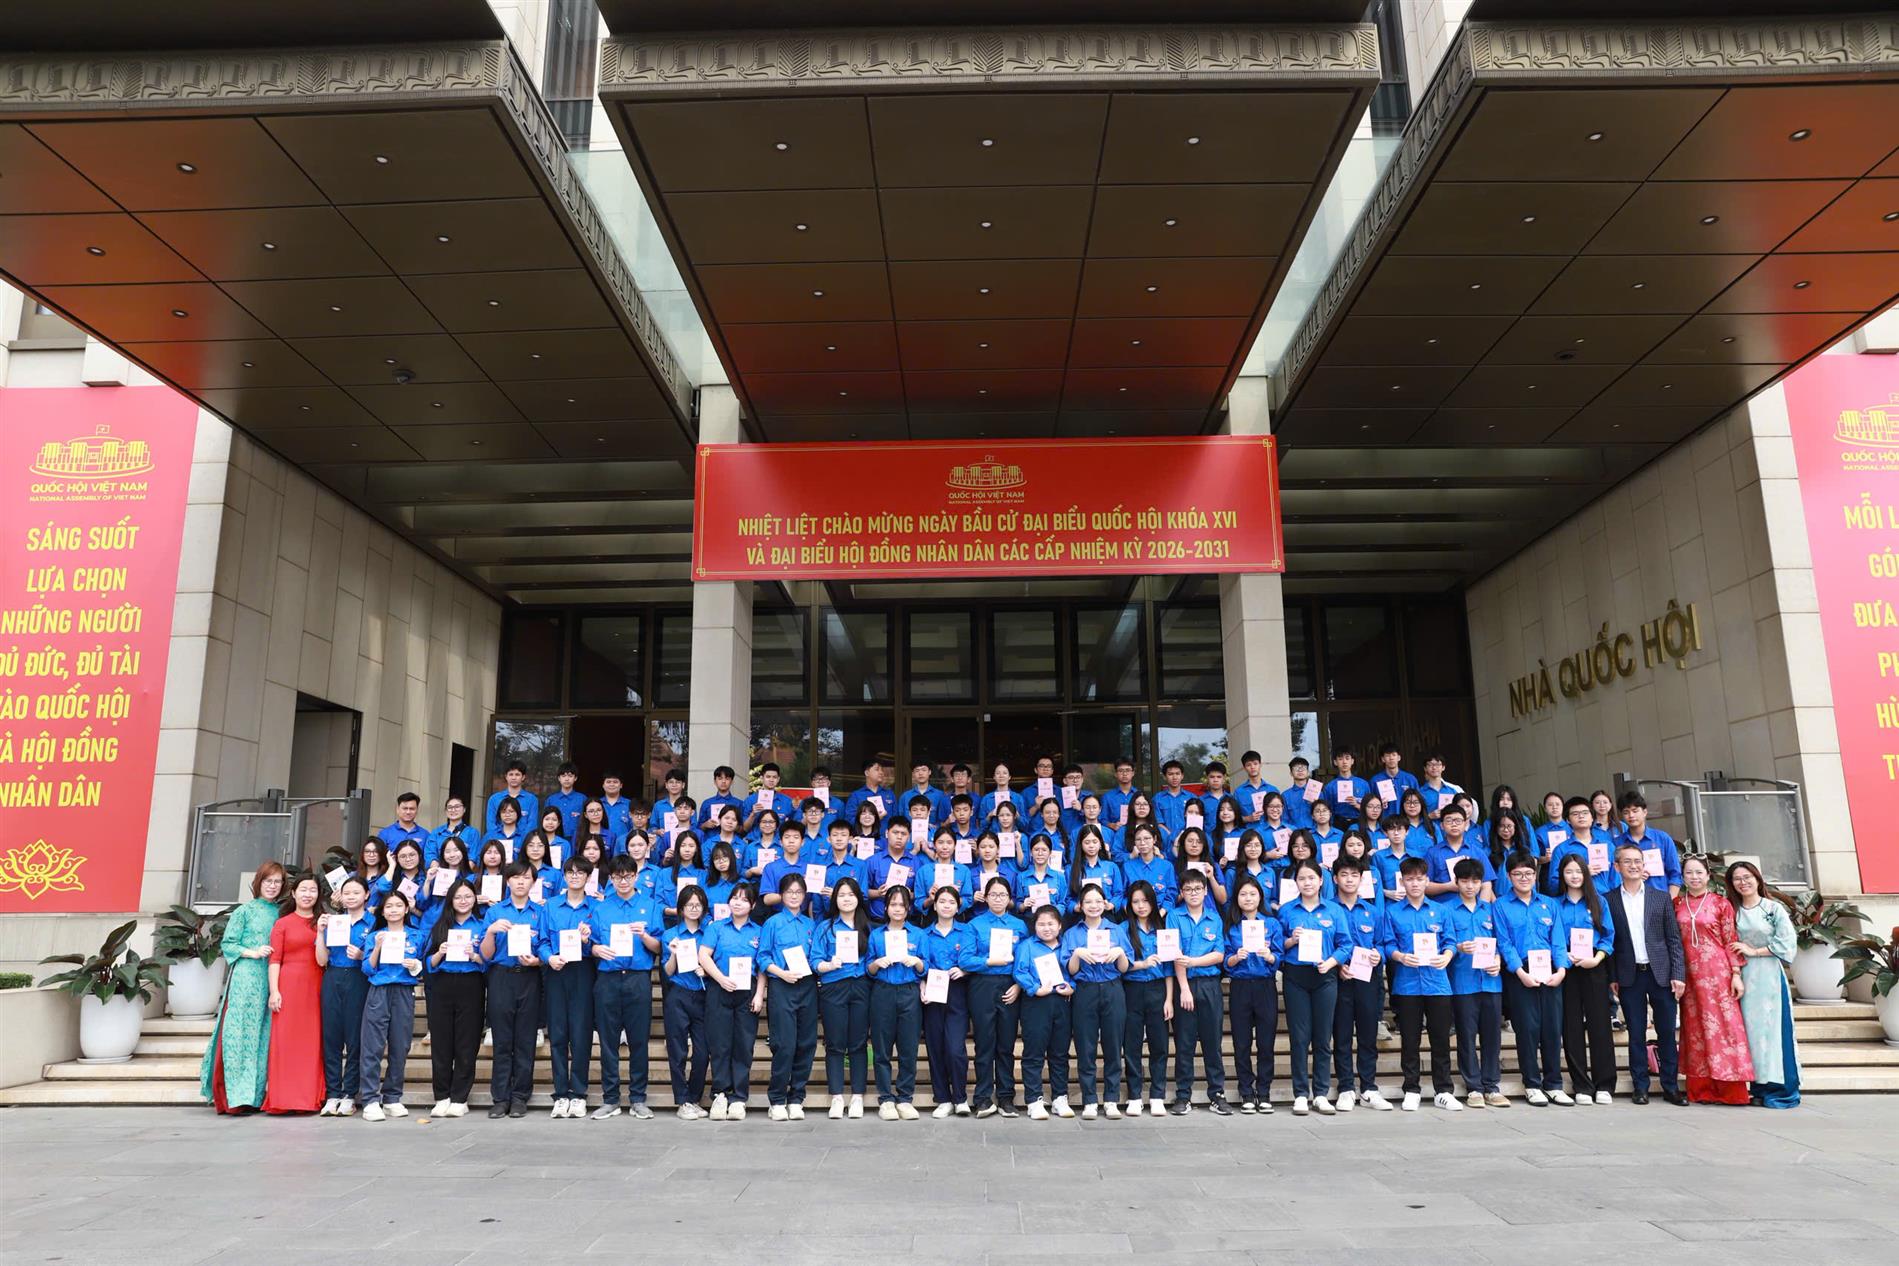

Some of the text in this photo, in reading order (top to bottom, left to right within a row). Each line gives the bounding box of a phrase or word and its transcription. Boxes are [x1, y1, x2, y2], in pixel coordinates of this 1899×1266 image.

[1841, 449, 1876, 461] QUỐC
[31, 480, 148, 495] QUỐC HỘI VIỆT NAM
[948, 490, 970, 498] QUỐC
[972, 491, 985, 499] HỘI
[987, 490, 1004, 499] VIỆT
[738, 504, 1237, 540] NHIỆT LIỆT CHÀO MỪNG NGÀY BẦU CỬ ĐẠI BIỂU QUỐC HỘI KHÓA XVI
[1843, 492, 1883, 529] MỖI
[26, 515, 140, 551] SÁNG SUỐT
[747, 534, 1230, 570] VÀ ĐẠI BIỂU HỘI ĐỒNG NHÂN DÂN CÁC CẤP NHIỆM KỲ 2026-2031
[26, 566, 127, 599] LỰA CHỌN
[1, 602, 142, 634] NHỮNG NGƯỜI
[1853, 600, 1899, 627] ĐƯA
[25, 644, 69, 681] ĐỨC,
[76, 645, 103, 676] ĐỦ
[110, 643, 140, 675] TÀI
[1508, 598, 1703, 719] NHÀ QUỐC HỘI
[0, 682, 131, 726] ÀO QUỐC HỘI
[0, 725, 118, 770] À HỘI ĐỒNG
[58, 774, 102, 807] DÂN
